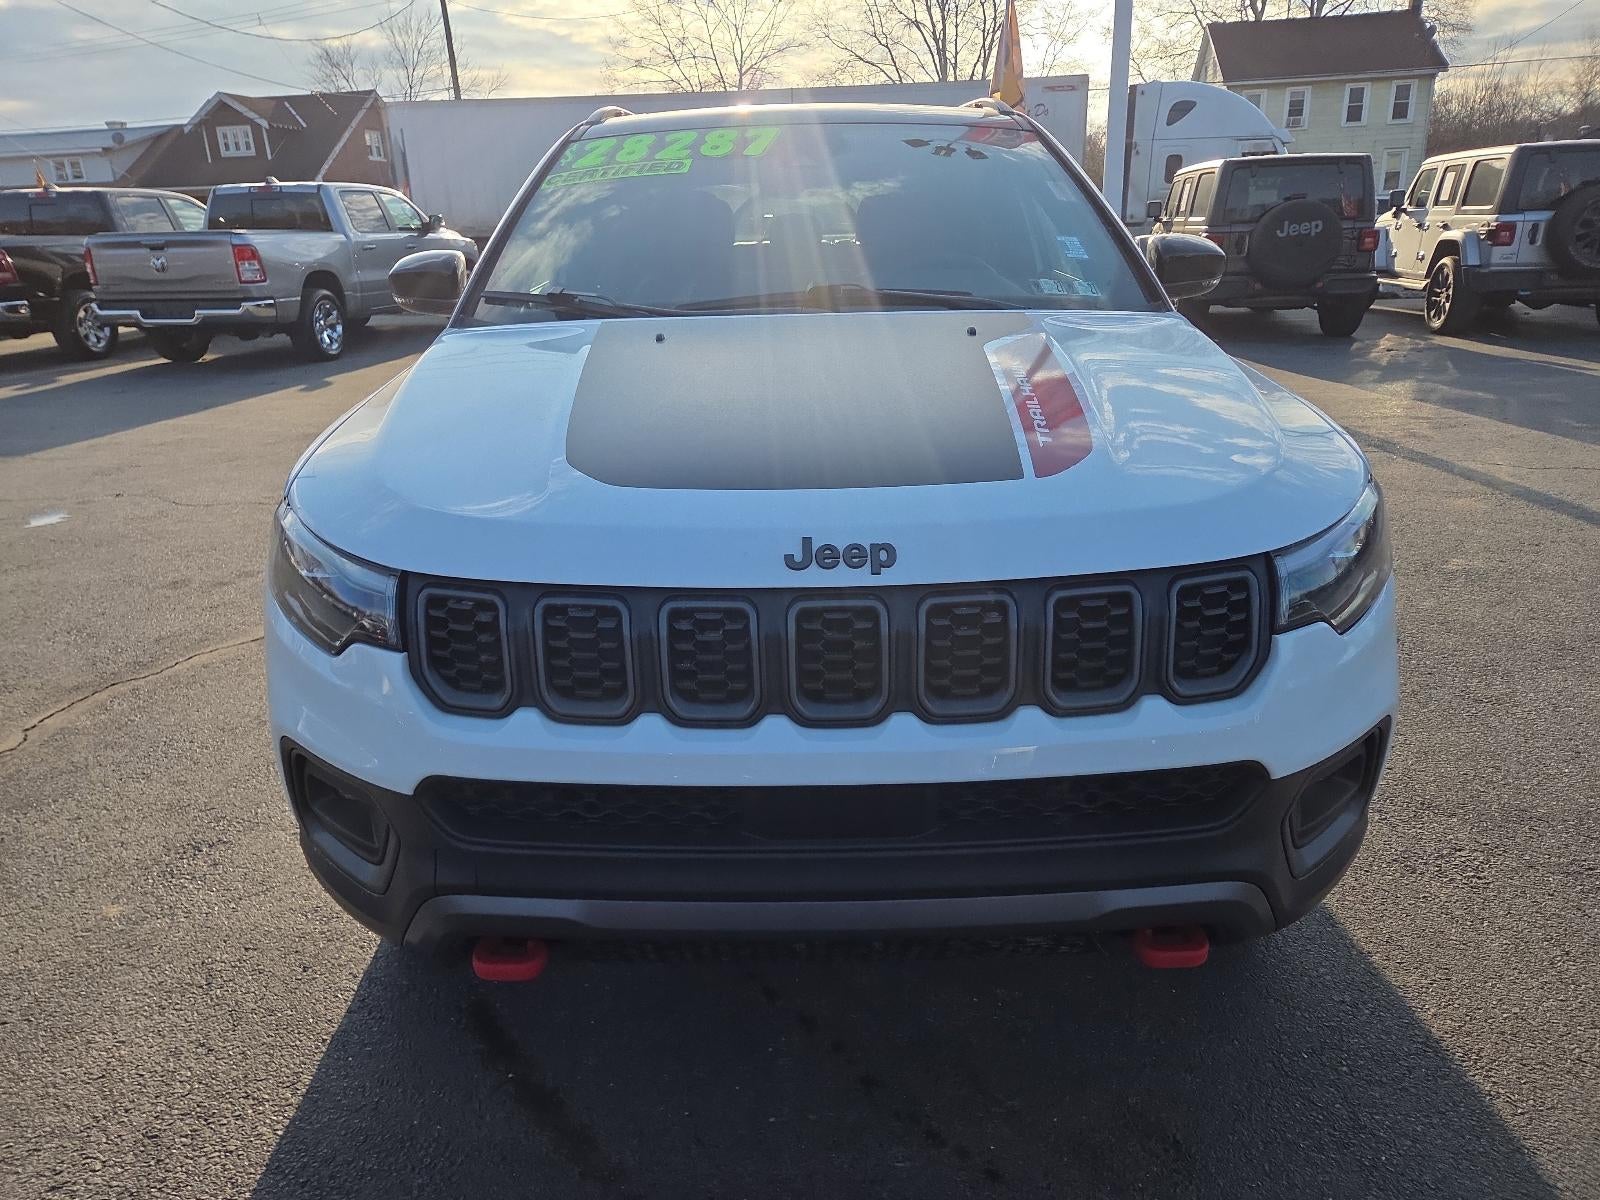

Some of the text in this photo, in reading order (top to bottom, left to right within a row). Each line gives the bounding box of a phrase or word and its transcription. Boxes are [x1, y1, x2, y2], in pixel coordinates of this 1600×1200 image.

[544, 159, 686, 187] CERTIFIED
[1276, 220, 1324, 238] Jeep
[1014, 367, 1053, 448] TRAILHAW
[784, 537, 897, 575] Jeep
